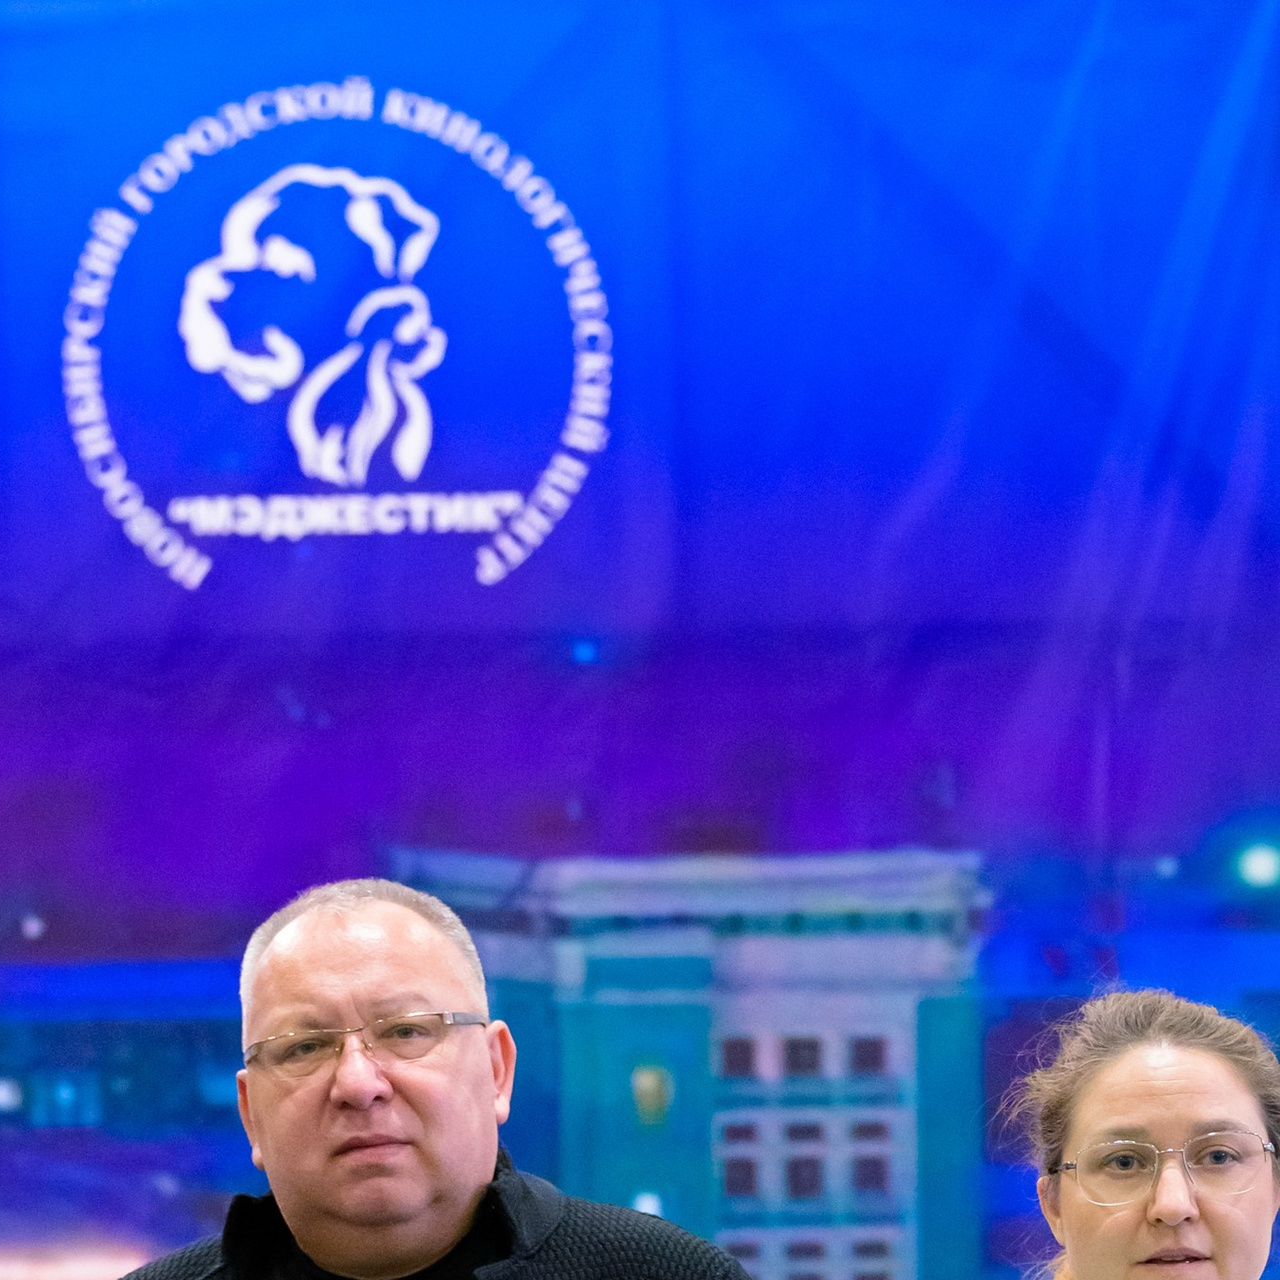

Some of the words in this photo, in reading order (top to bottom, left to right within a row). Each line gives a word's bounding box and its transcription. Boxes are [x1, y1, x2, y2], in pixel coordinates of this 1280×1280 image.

[120, 75, 375, 215] ГОРОДСКОЙ
[381, 88, 613, 453] КИНОЛОГИЧЕСКИЙ
[61, 207, 212, 590] НОВОСИБИРСКИЙ
